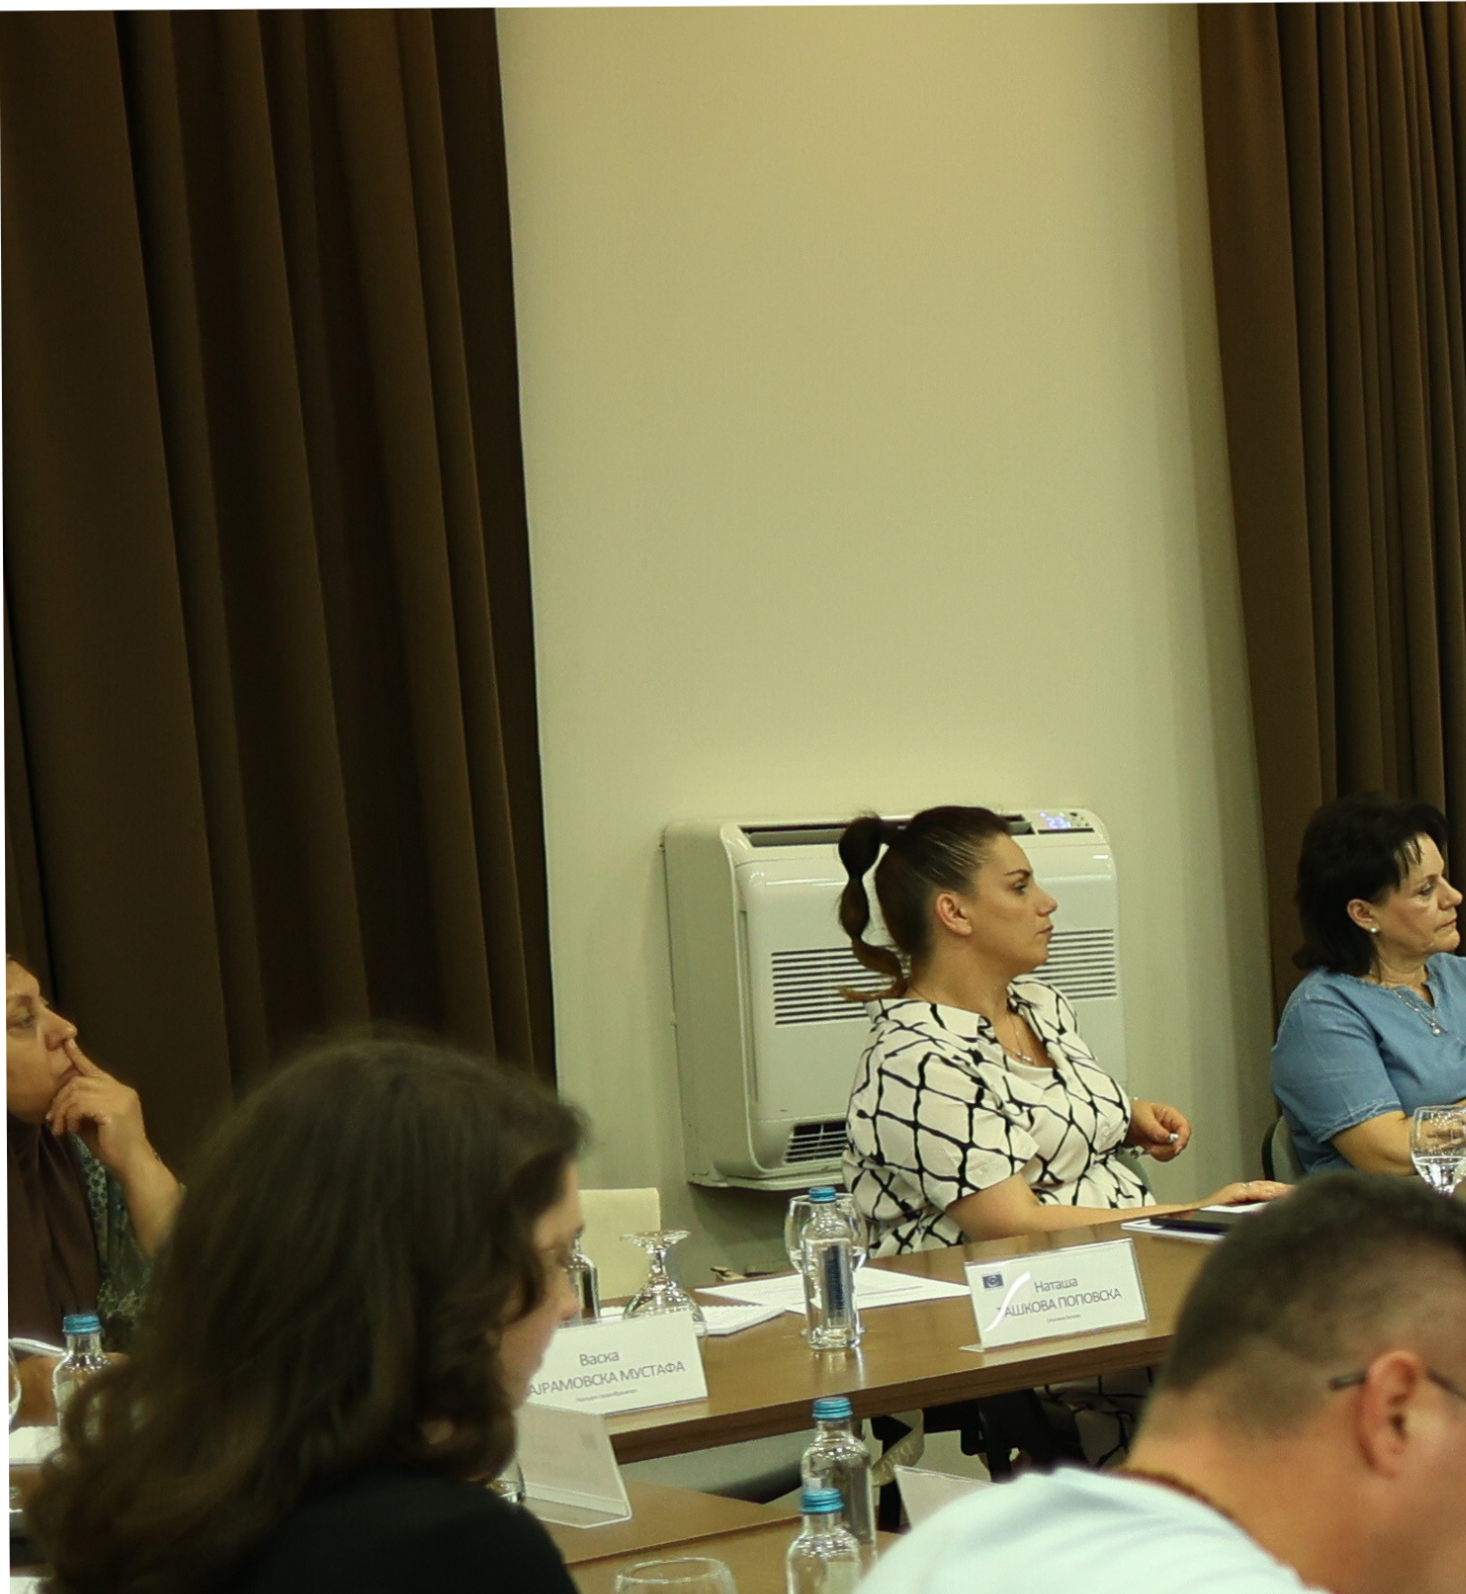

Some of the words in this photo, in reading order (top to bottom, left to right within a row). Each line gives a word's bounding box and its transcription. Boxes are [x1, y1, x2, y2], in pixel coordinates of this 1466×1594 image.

[1034, 1276, 1079, 1293] Наташа
[1058, 1287, 1123, 1308] ПОПОВСКА
[579, 1351, 620, 1367] Васка
[529, 1371, 617, 1397] АЈРАМОВСКА
[620, 1360, 686, 1382] МУСТАФА
